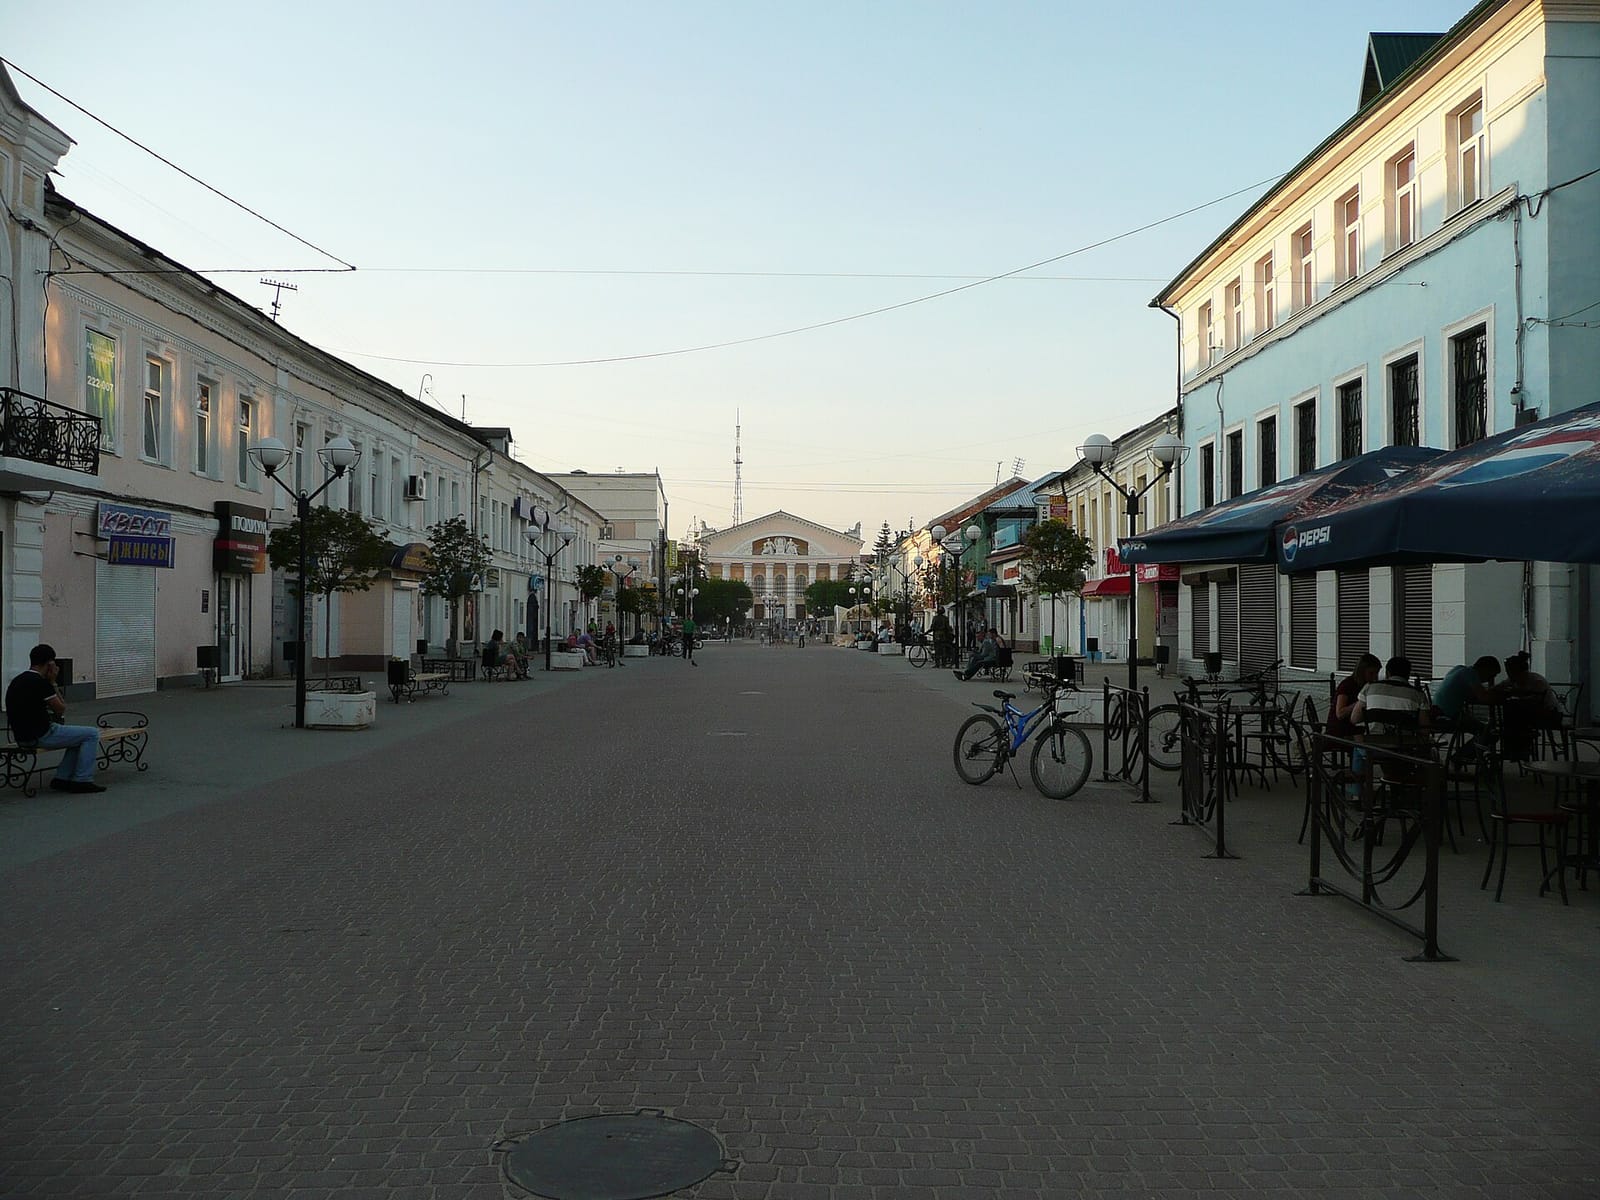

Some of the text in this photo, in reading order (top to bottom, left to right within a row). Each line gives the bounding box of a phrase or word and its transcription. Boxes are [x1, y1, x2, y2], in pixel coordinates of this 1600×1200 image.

[102, 510, 169, 537] КВЕСТ
[231, 515, 267, 535] ПОДИУМ
[1298, 525, 1331, 548] PEPSI
[111, 541, 168, 562] ДЖИНСЫ
